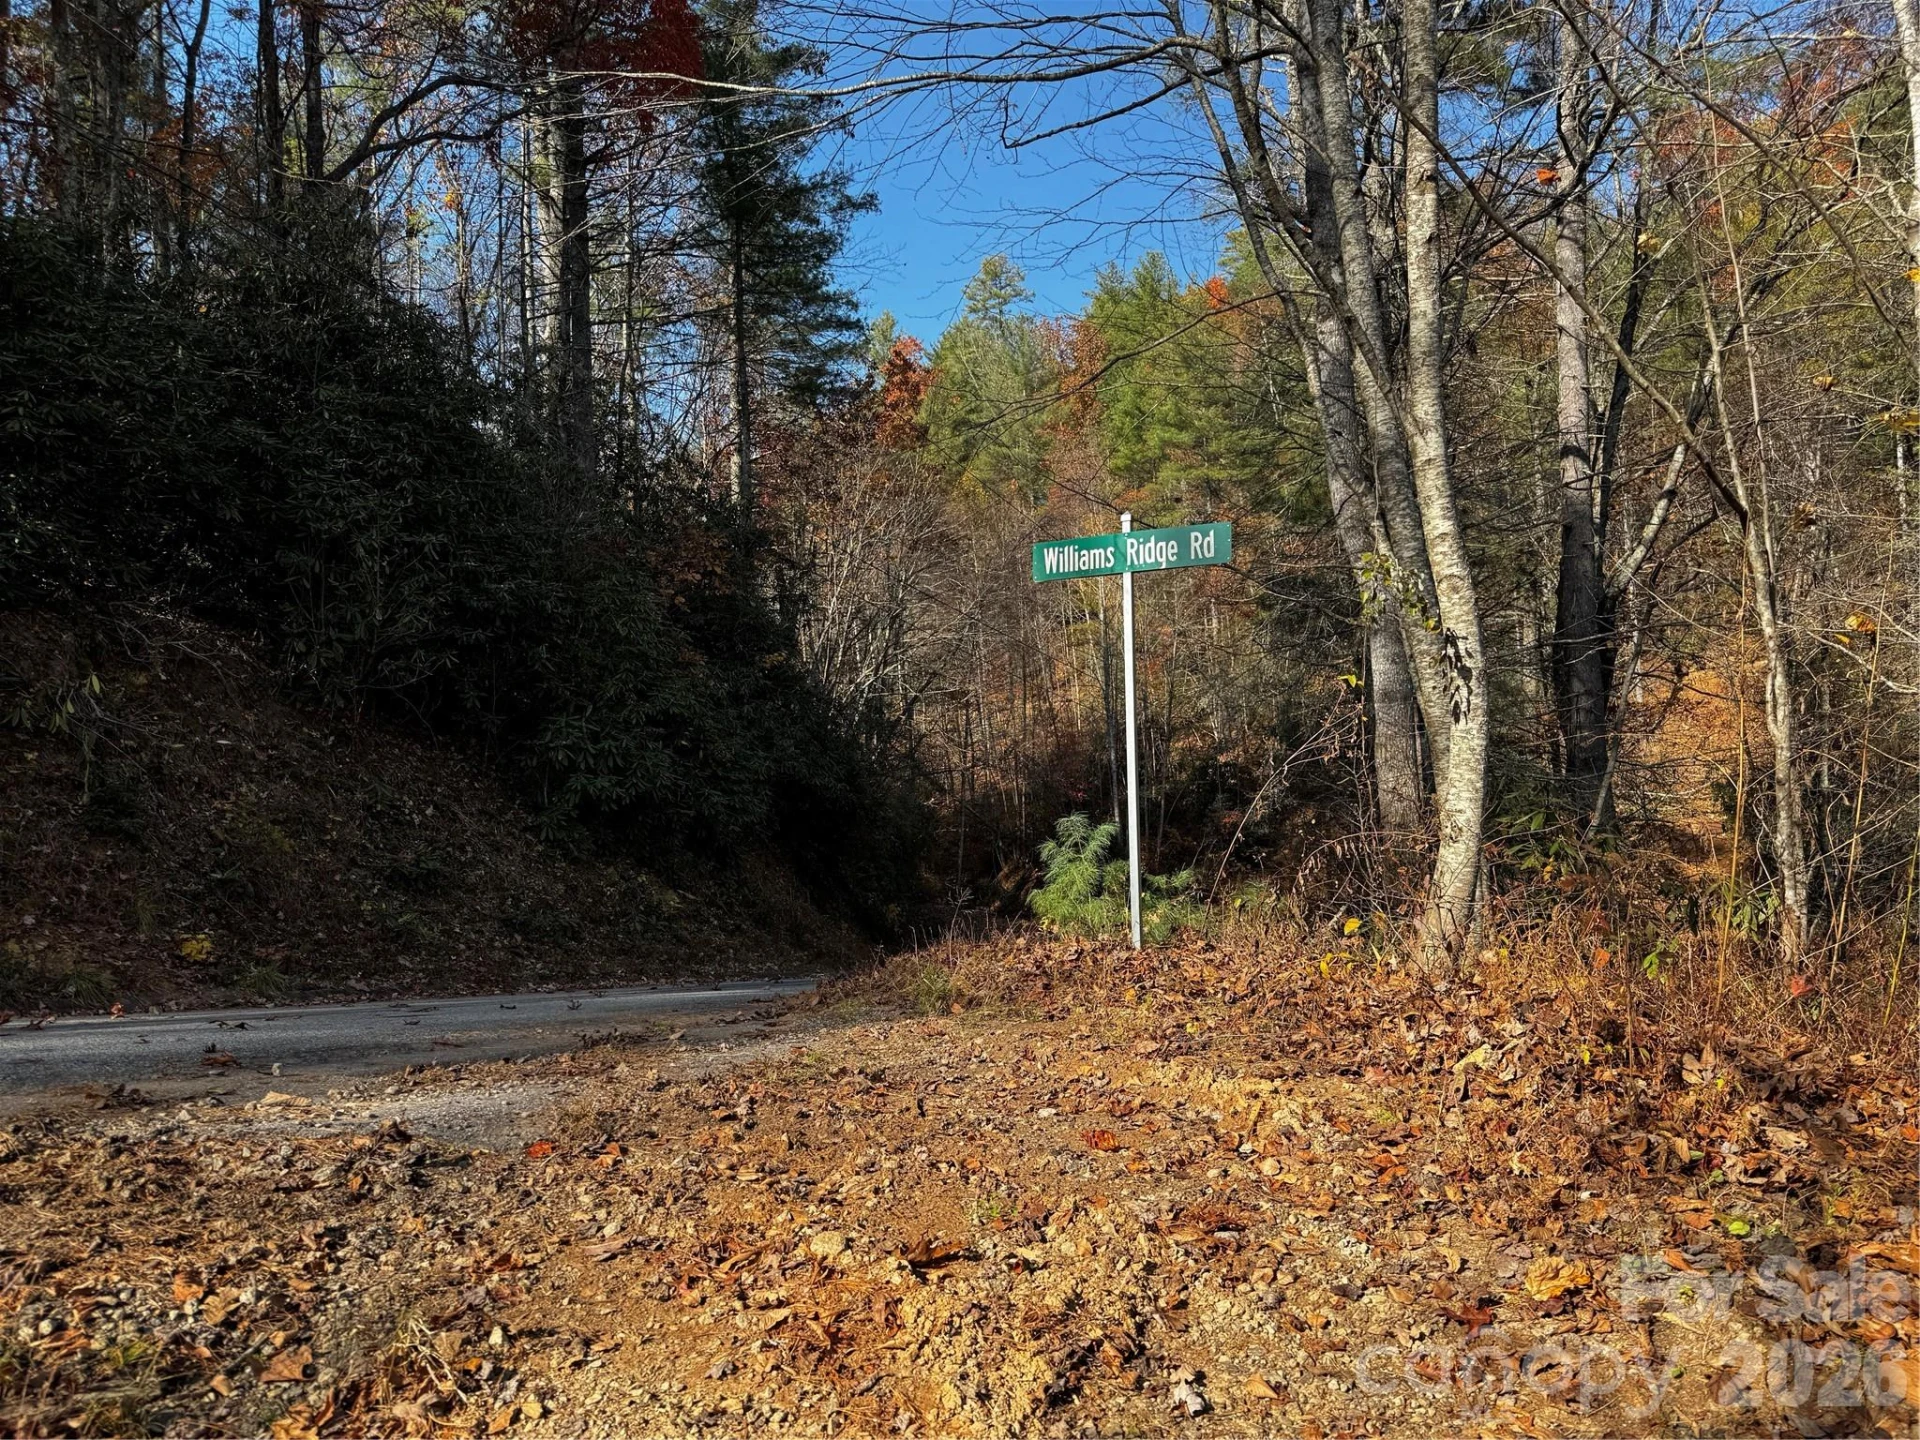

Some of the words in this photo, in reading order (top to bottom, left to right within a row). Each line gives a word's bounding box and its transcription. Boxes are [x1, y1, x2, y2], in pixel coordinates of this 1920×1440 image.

[1044, 545, 1115, 574] Williams
[1126, 535, 1178, 569] Ridge
[1190, 529, 1215, 560] Rd
